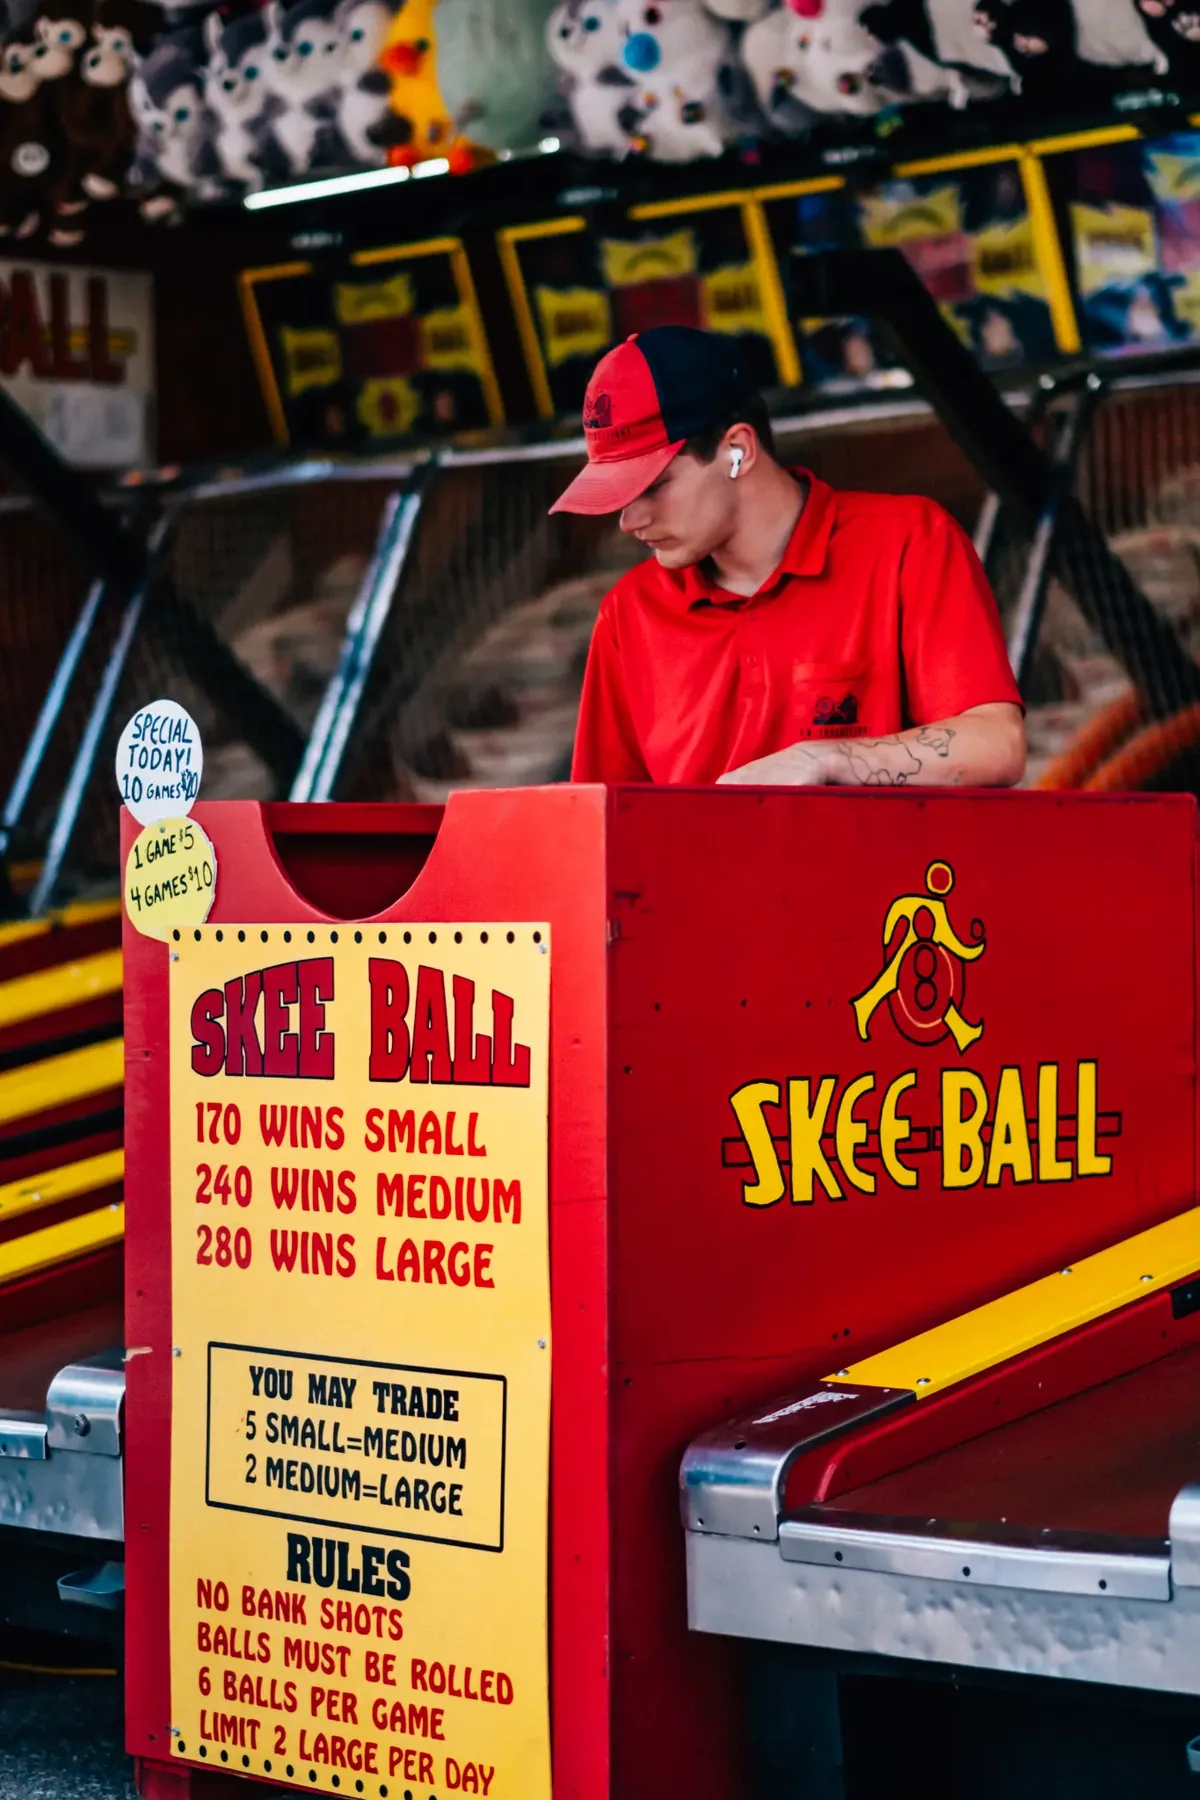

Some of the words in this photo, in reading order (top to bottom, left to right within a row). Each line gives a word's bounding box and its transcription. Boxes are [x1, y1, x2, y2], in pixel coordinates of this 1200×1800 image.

[0, 268, 127, 388] ALL
[128, 744, 191, 774] TODAY!
[132, 713, 193, 744] SPECIAL
[122, 774, 142, 803] 10
[147, 783, 181, 800] GAMES
[135, 844, 143, 869] 1
[146, 835, 176, 863] GAME
[179, 826, 194, 850] $5
[130, 886, 141, 911] 4
[144, 874, 188, 907] GAMES
[189, 861, 213, 891] $10
[190, 956, 335, 1081] SKEE
[367, 956, 531, 1088] BALL
[195, 1101, 241, 1146] 170
[259, 1104, 345, 1151] WINS
[363, 1107, 487, 1157] SMALL
[729, 1070, 919, 1209] SKEE
[941, 1059, 1113, 1190] BALL
[195, 1163, 253, 1208] 240
[269, 1167, 357, 1214] WINS
[376, 1173, 521, 1224] MEDIUM
[195, 1223, 253, 1269] 280
[269, 1227, 357, 1278] WINS
[375, 1236, 496, 1288] LARGE
[249, 1365, 293, 1400] YOU
[308, 1373, 357, 1409] MAY
[373, 1381, 460, 1422] TRADE
[245, 1410, 257, 1441] 5
[245, 1454, 257, 1484] 2
[286, 1532, 412, 1601] RULES
[196, 1578, 230, 1611] NO
[242, 1585, 307, 1626] BANK
[320, 1598, 404, 1641] SHOTS
[197, 1621, 271, 1663] BALLS
[283, 1637, 351, 1677] MUST
[365, 1652, 397, 1686] BE
[410, 1659, 515, 1705] ROLLED
[198, 1666, 212, 1696] 6
[224, 1670, 298, 1713] BALLS
[310, 1687, 359, 1726] PER
[372, 1699, 446, 1741] GAME
[199, 1709, 260, 1750] LIMIT
[274, 1726, 288, 1756] 2
[299, 1730, 379, 1775] LARGE
[389, 1746, 435, 1784] PER
[445, 1757, 495, 1796] DAY
